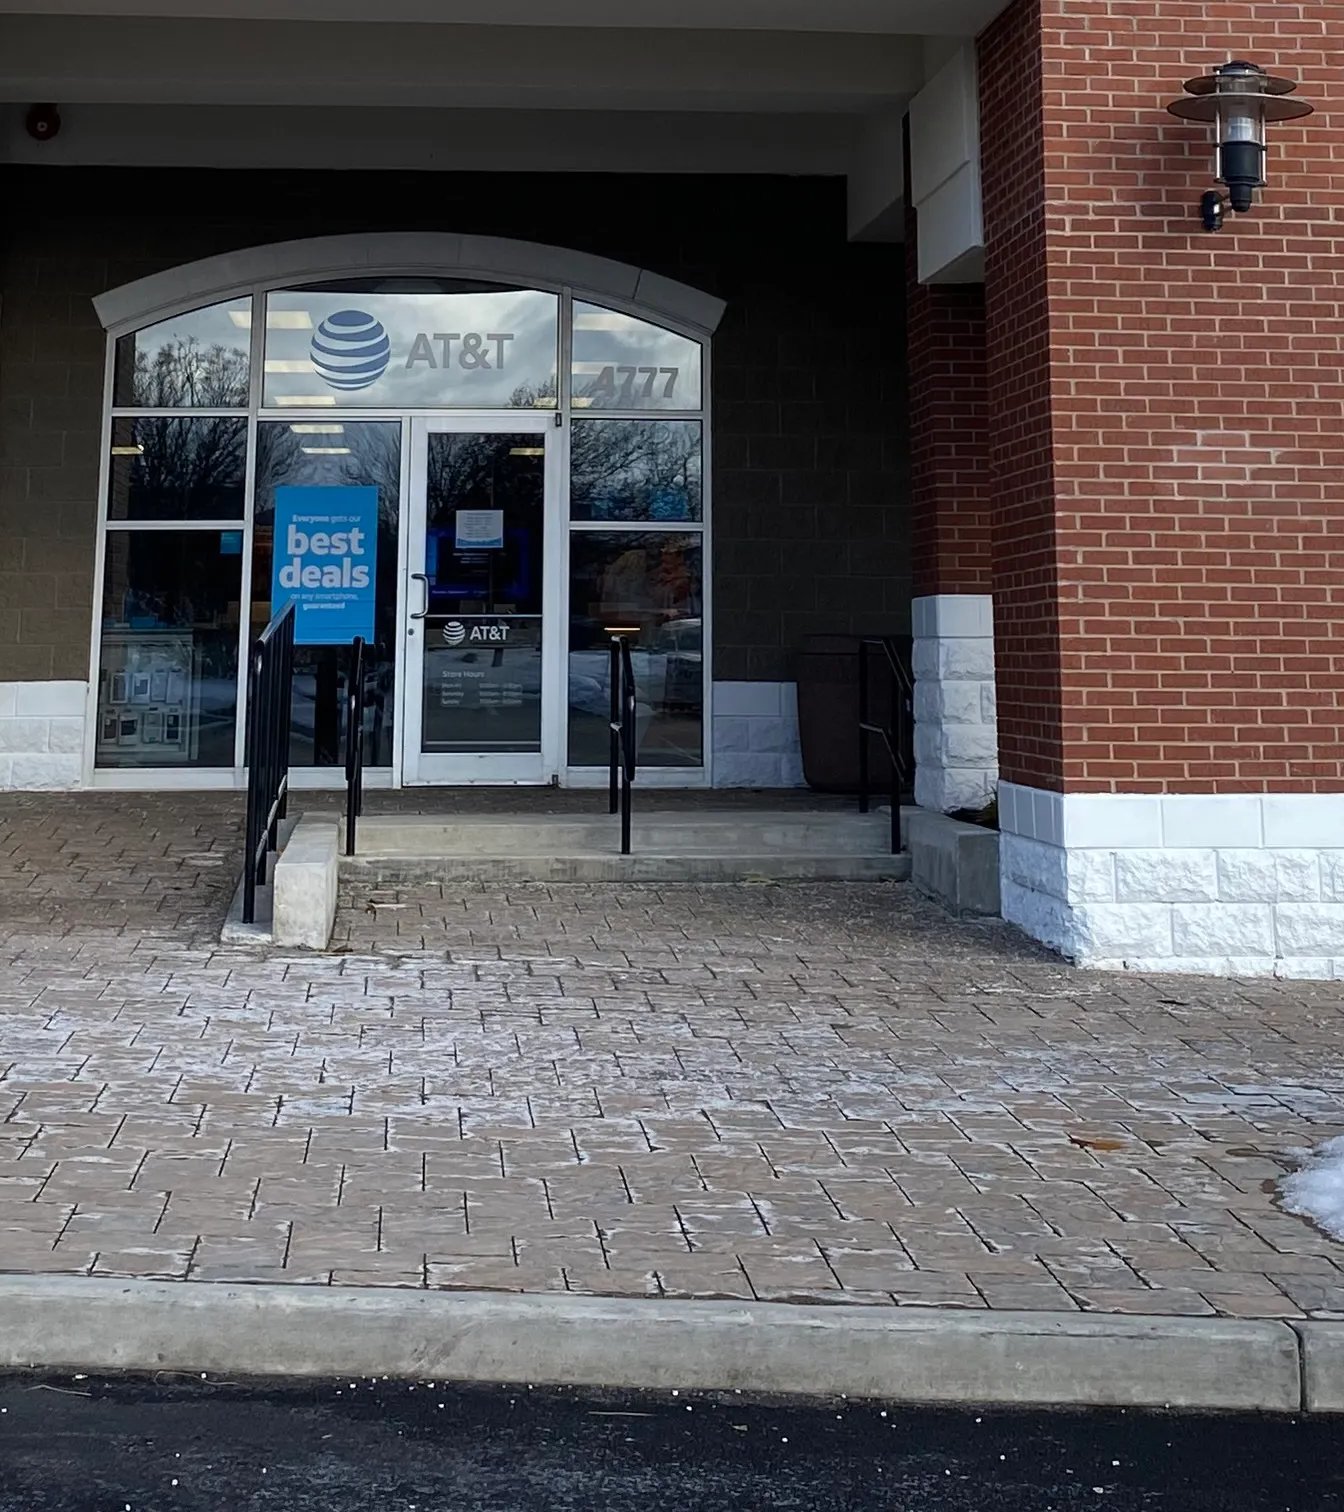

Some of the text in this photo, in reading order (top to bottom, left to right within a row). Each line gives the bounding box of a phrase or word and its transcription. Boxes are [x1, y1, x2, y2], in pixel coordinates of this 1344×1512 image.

[406, 332, 514, 370] AT&T
[592, 366, 679, 399] 4777
[292, 514, 329, 524] Everyone
[287, 524, 365, 555] best
[279, 557, 370, 589] deals
[469, 625, 510, 641] AT&T
